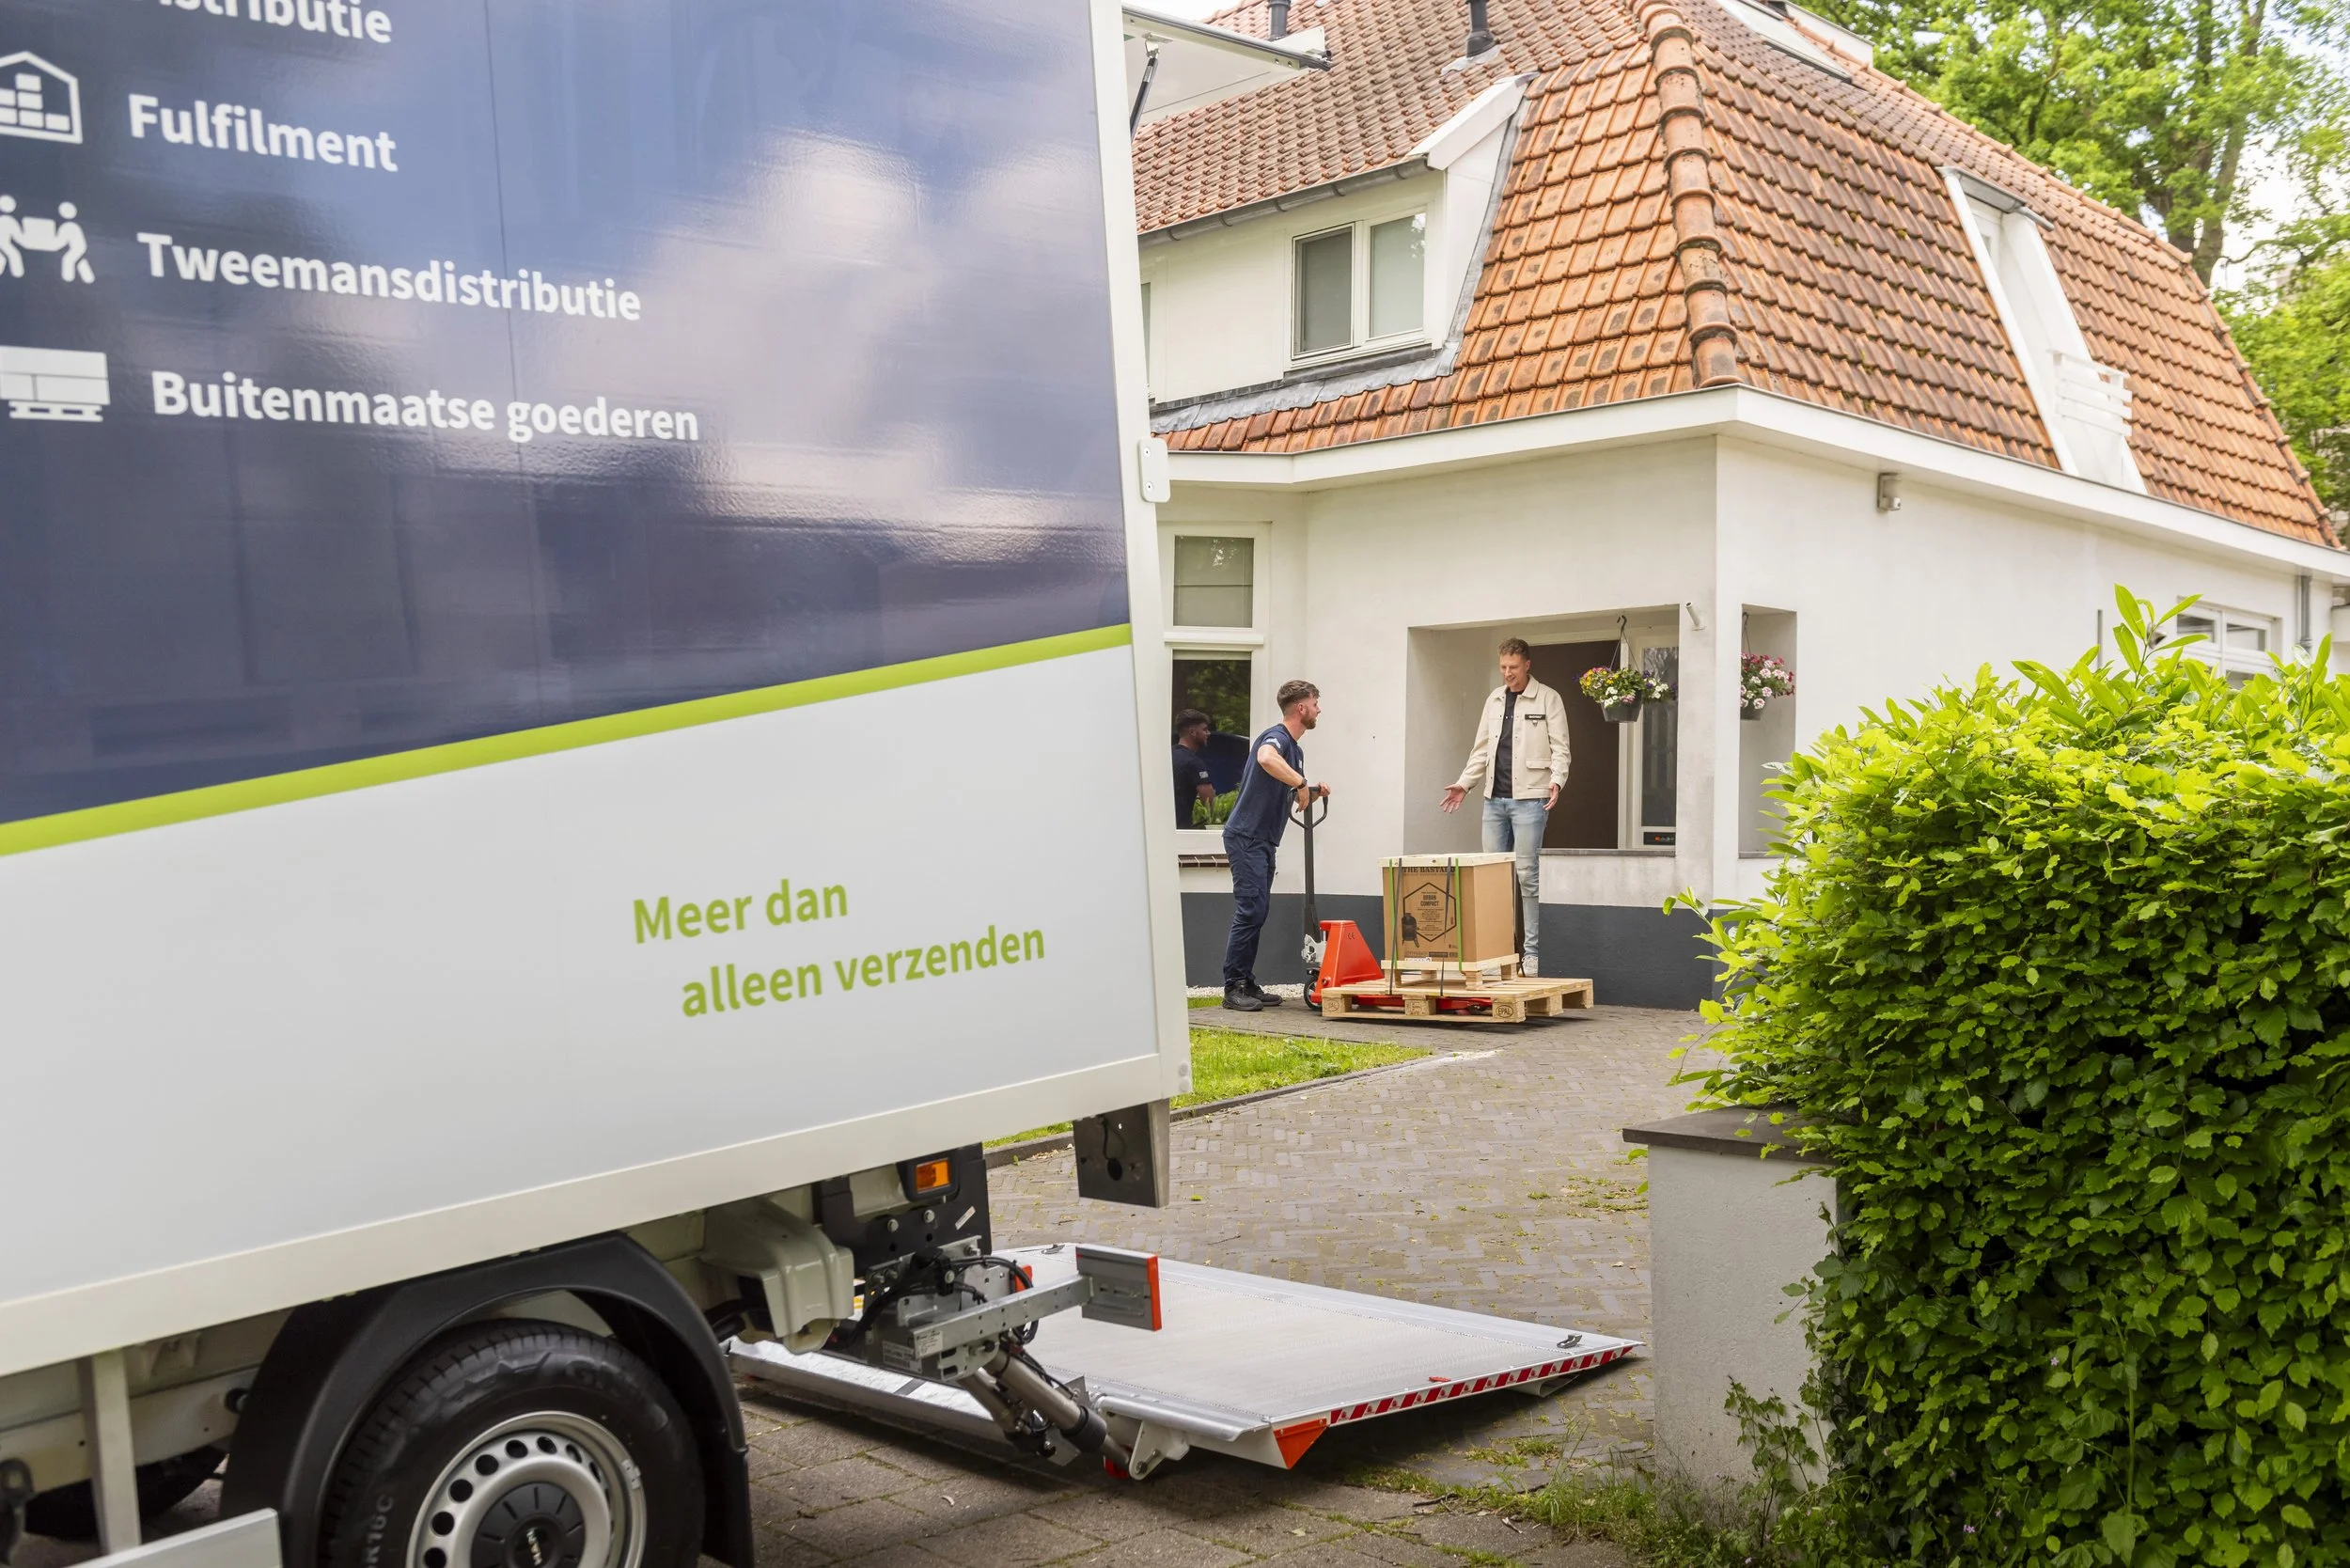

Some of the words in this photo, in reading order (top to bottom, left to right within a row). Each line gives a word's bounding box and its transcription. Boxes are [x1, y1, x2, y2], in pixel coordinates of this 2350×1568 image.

[129, 94, 399, 172] Fulfilment
[136, 231, 642, 321] Tweemansdistributie
[151, 369, 495, 431] Buitenmaatse
[506, 395, 699, 444] goederen
[634, 896, 752, 944] Meer
[765, 878, 848, 926] dan
[682, 963, 822, 1017] alleen
[835, 924, 1045, 991] verzenden
